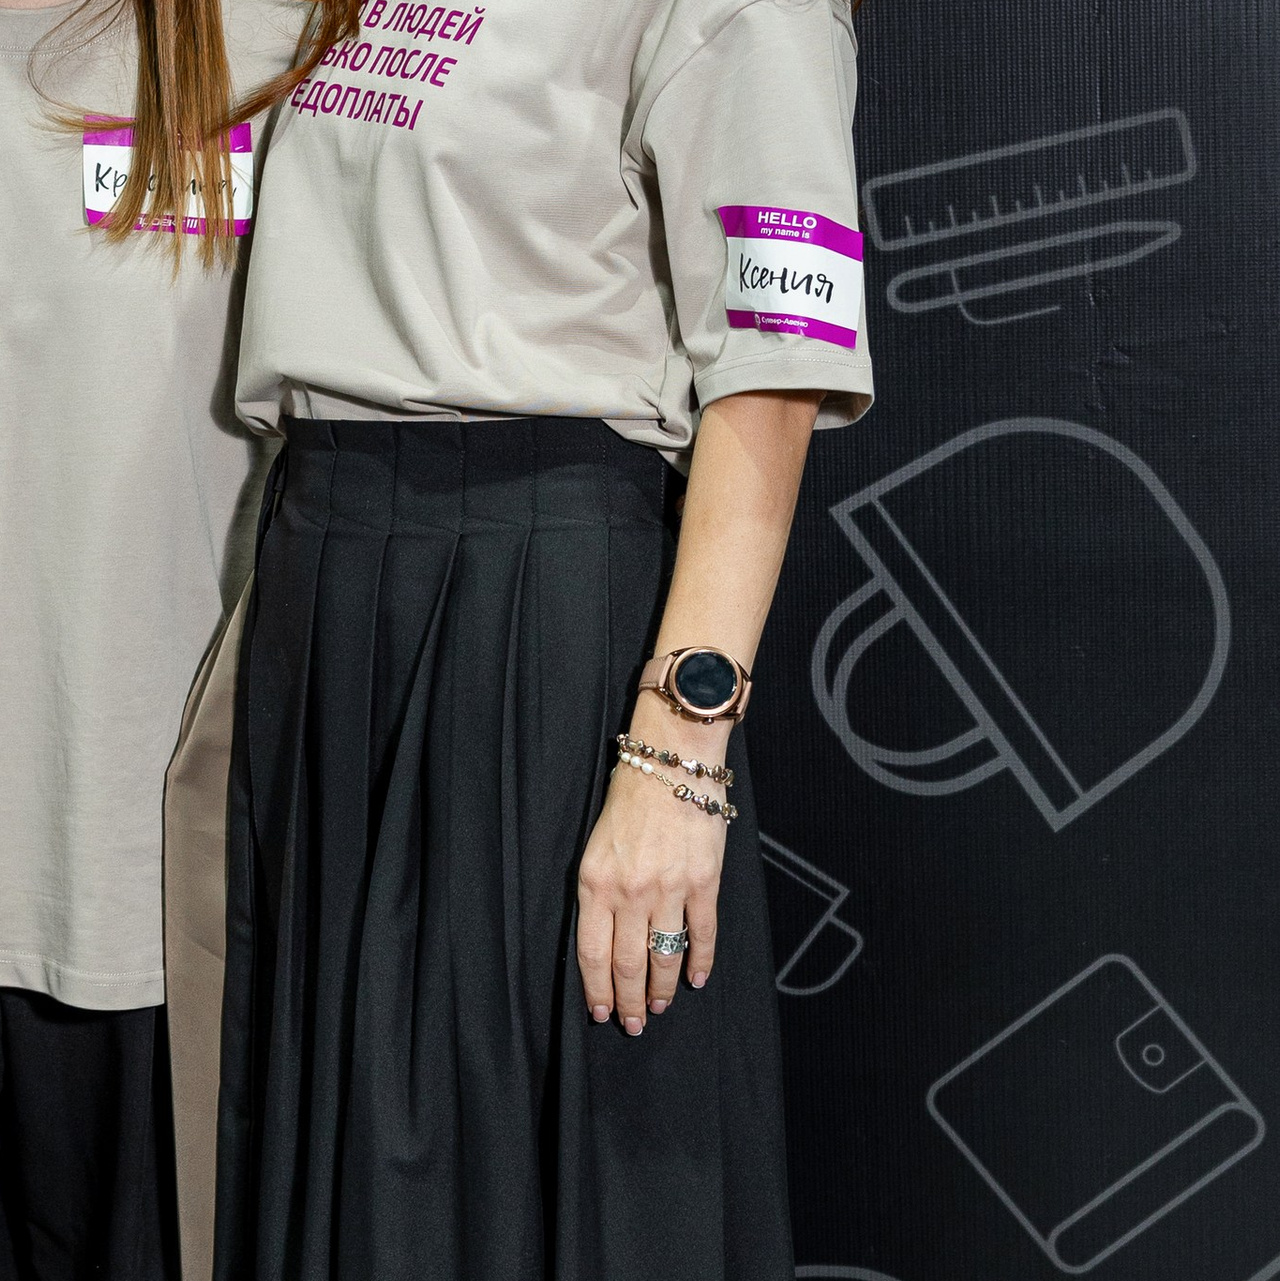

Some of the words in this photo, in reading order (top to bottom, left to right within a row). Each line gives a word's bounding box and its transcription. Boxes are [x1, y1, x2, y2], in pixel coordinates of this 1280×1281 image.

[363, 0, 388, 29] В
[382, 3, 486, 46] ЛЮДЕЙ
[319, 40, 373, 72] ЬКО
[368, 45, 458, 88] ПОСЛЕ
[290, 78, 424, 132] ЕДОПЛАТЫ
[757, 211, 817, 229] HELLO
[760, 227, 773, 236] my
[774, 228, 800, 238] name
[801, 229, 811, 239] is
[739, 252, 835, 304] Ксения
